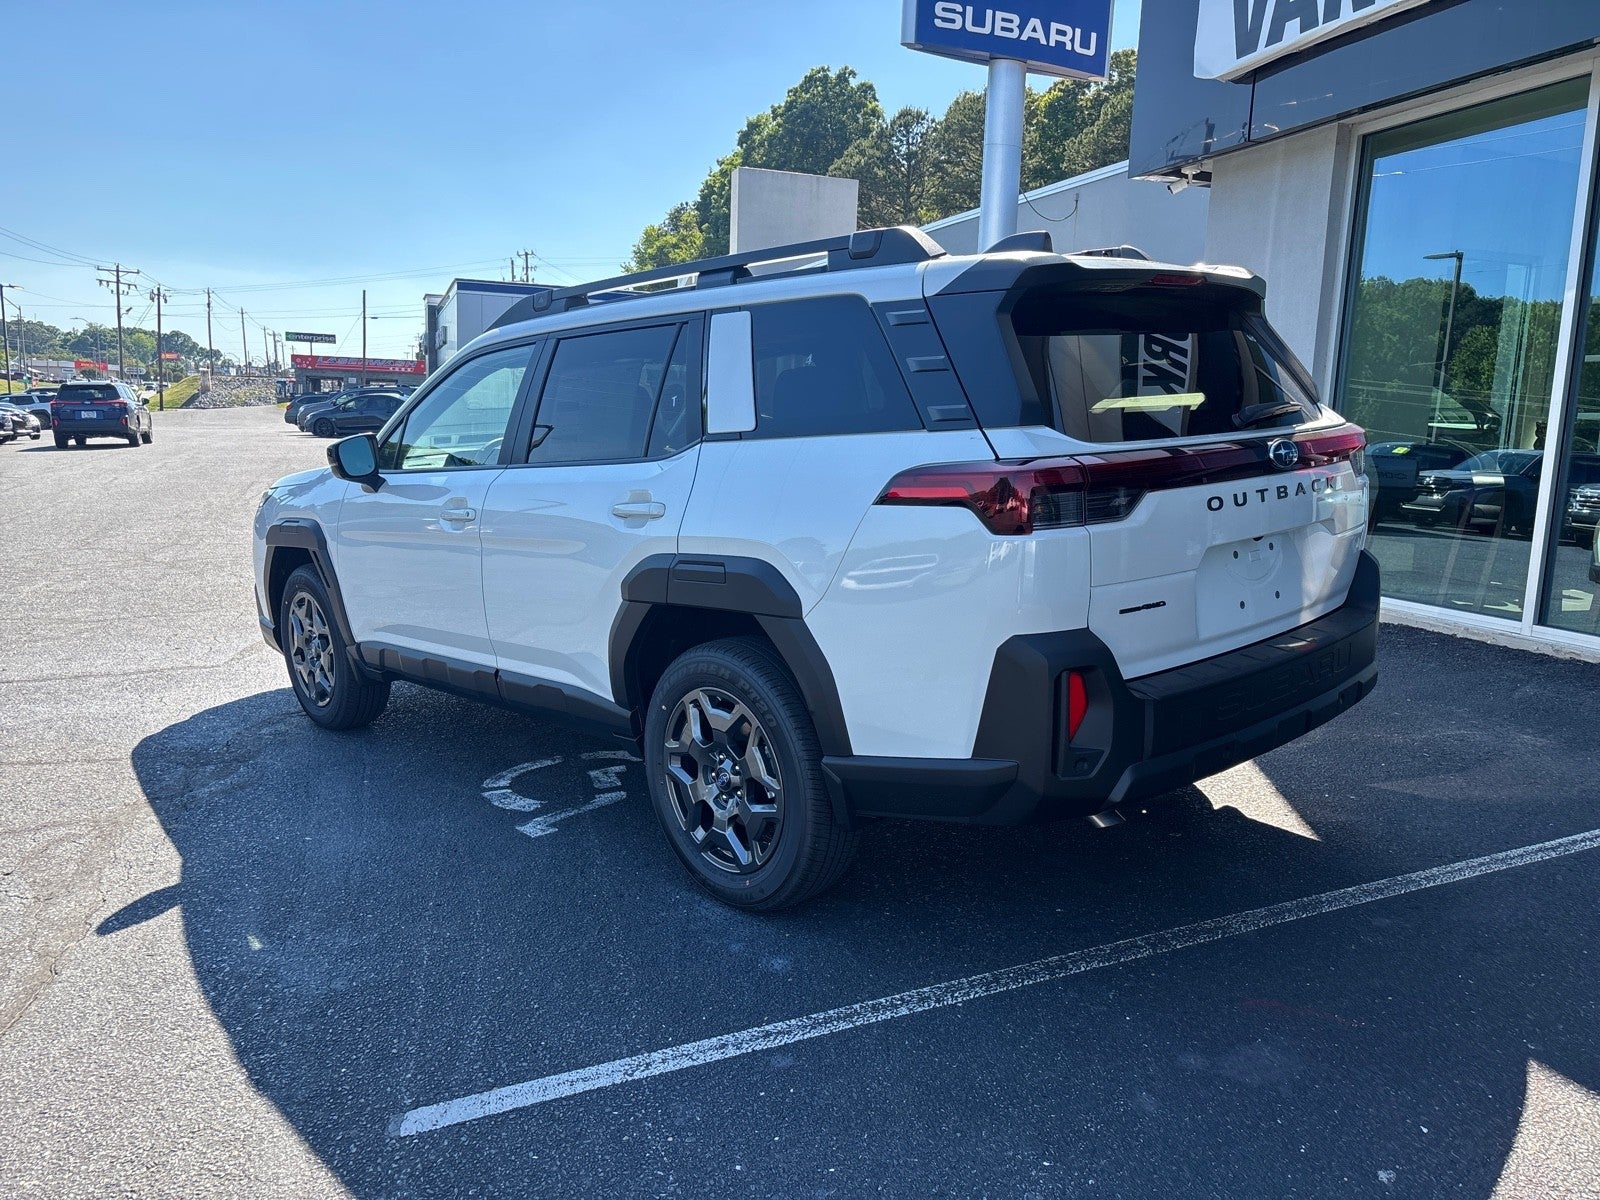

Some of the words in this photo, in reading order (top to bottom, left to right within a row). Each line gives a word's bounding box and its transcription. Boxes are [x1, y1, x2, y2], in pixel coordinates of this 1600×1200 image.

[933, 1, 1097, 57] SUBARU
[287, 332, 336, 343] enterprise
[1206, 475, 1335, 512] OUTBACK
